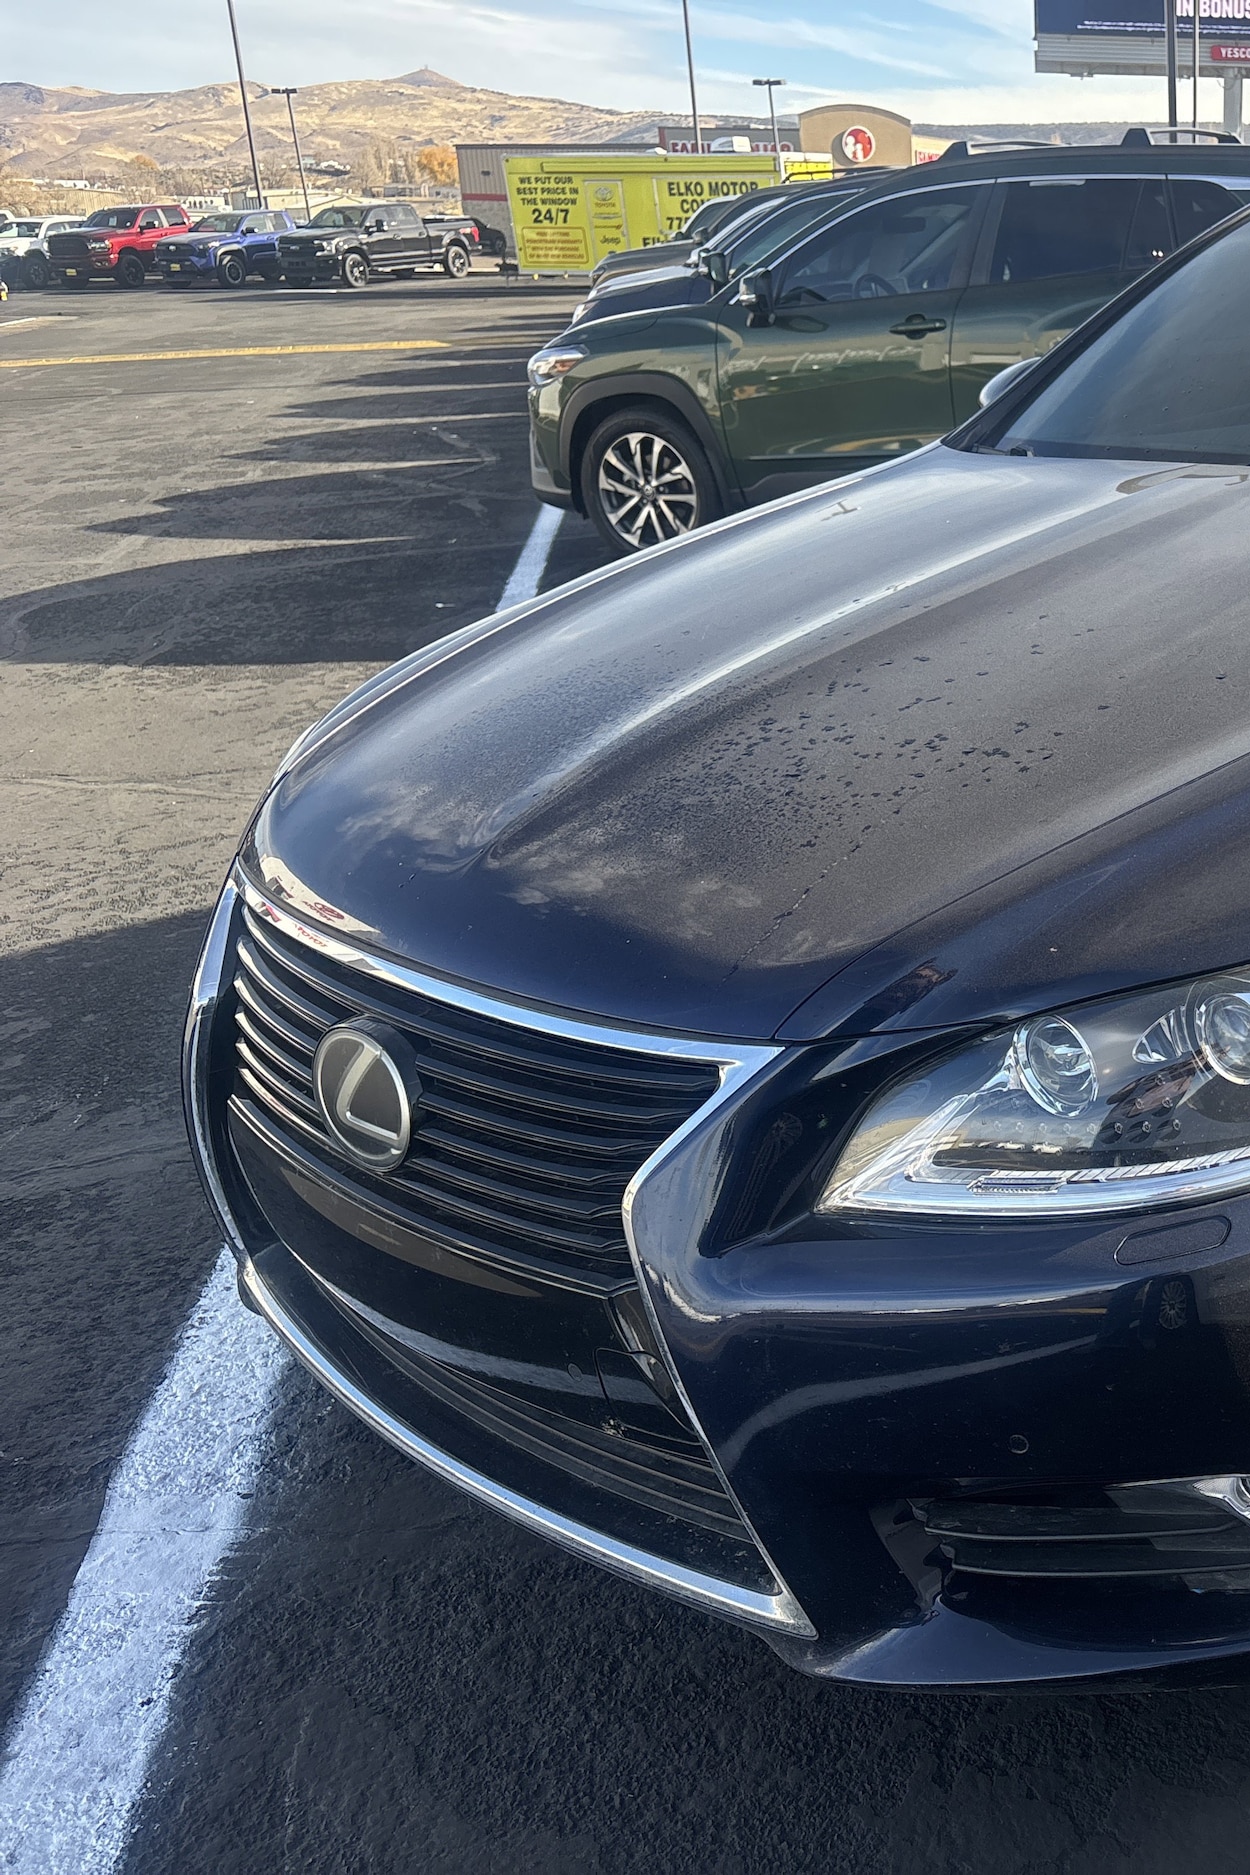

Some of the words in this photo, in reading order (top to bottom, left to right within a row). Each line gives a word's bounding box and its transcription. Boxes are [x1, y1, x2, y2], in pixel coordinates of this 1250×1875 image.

[1175, 0, 1194, 17] IN
[518, 176, 533, 185] WE
[534, 176, 552, 185] PUT
[554, 176, 574, 185] OUR
[516, 187, 539, 195] BEST
[540, 187, 567, 195] PRICE
[569, 187, 579, 195] IN
[667, 181, 704, 197] ELKO
[520, 198, 539, 206] THE
[541, 198, 578, 206] WINDOW
[531, 208, 570, 225] 24/7
